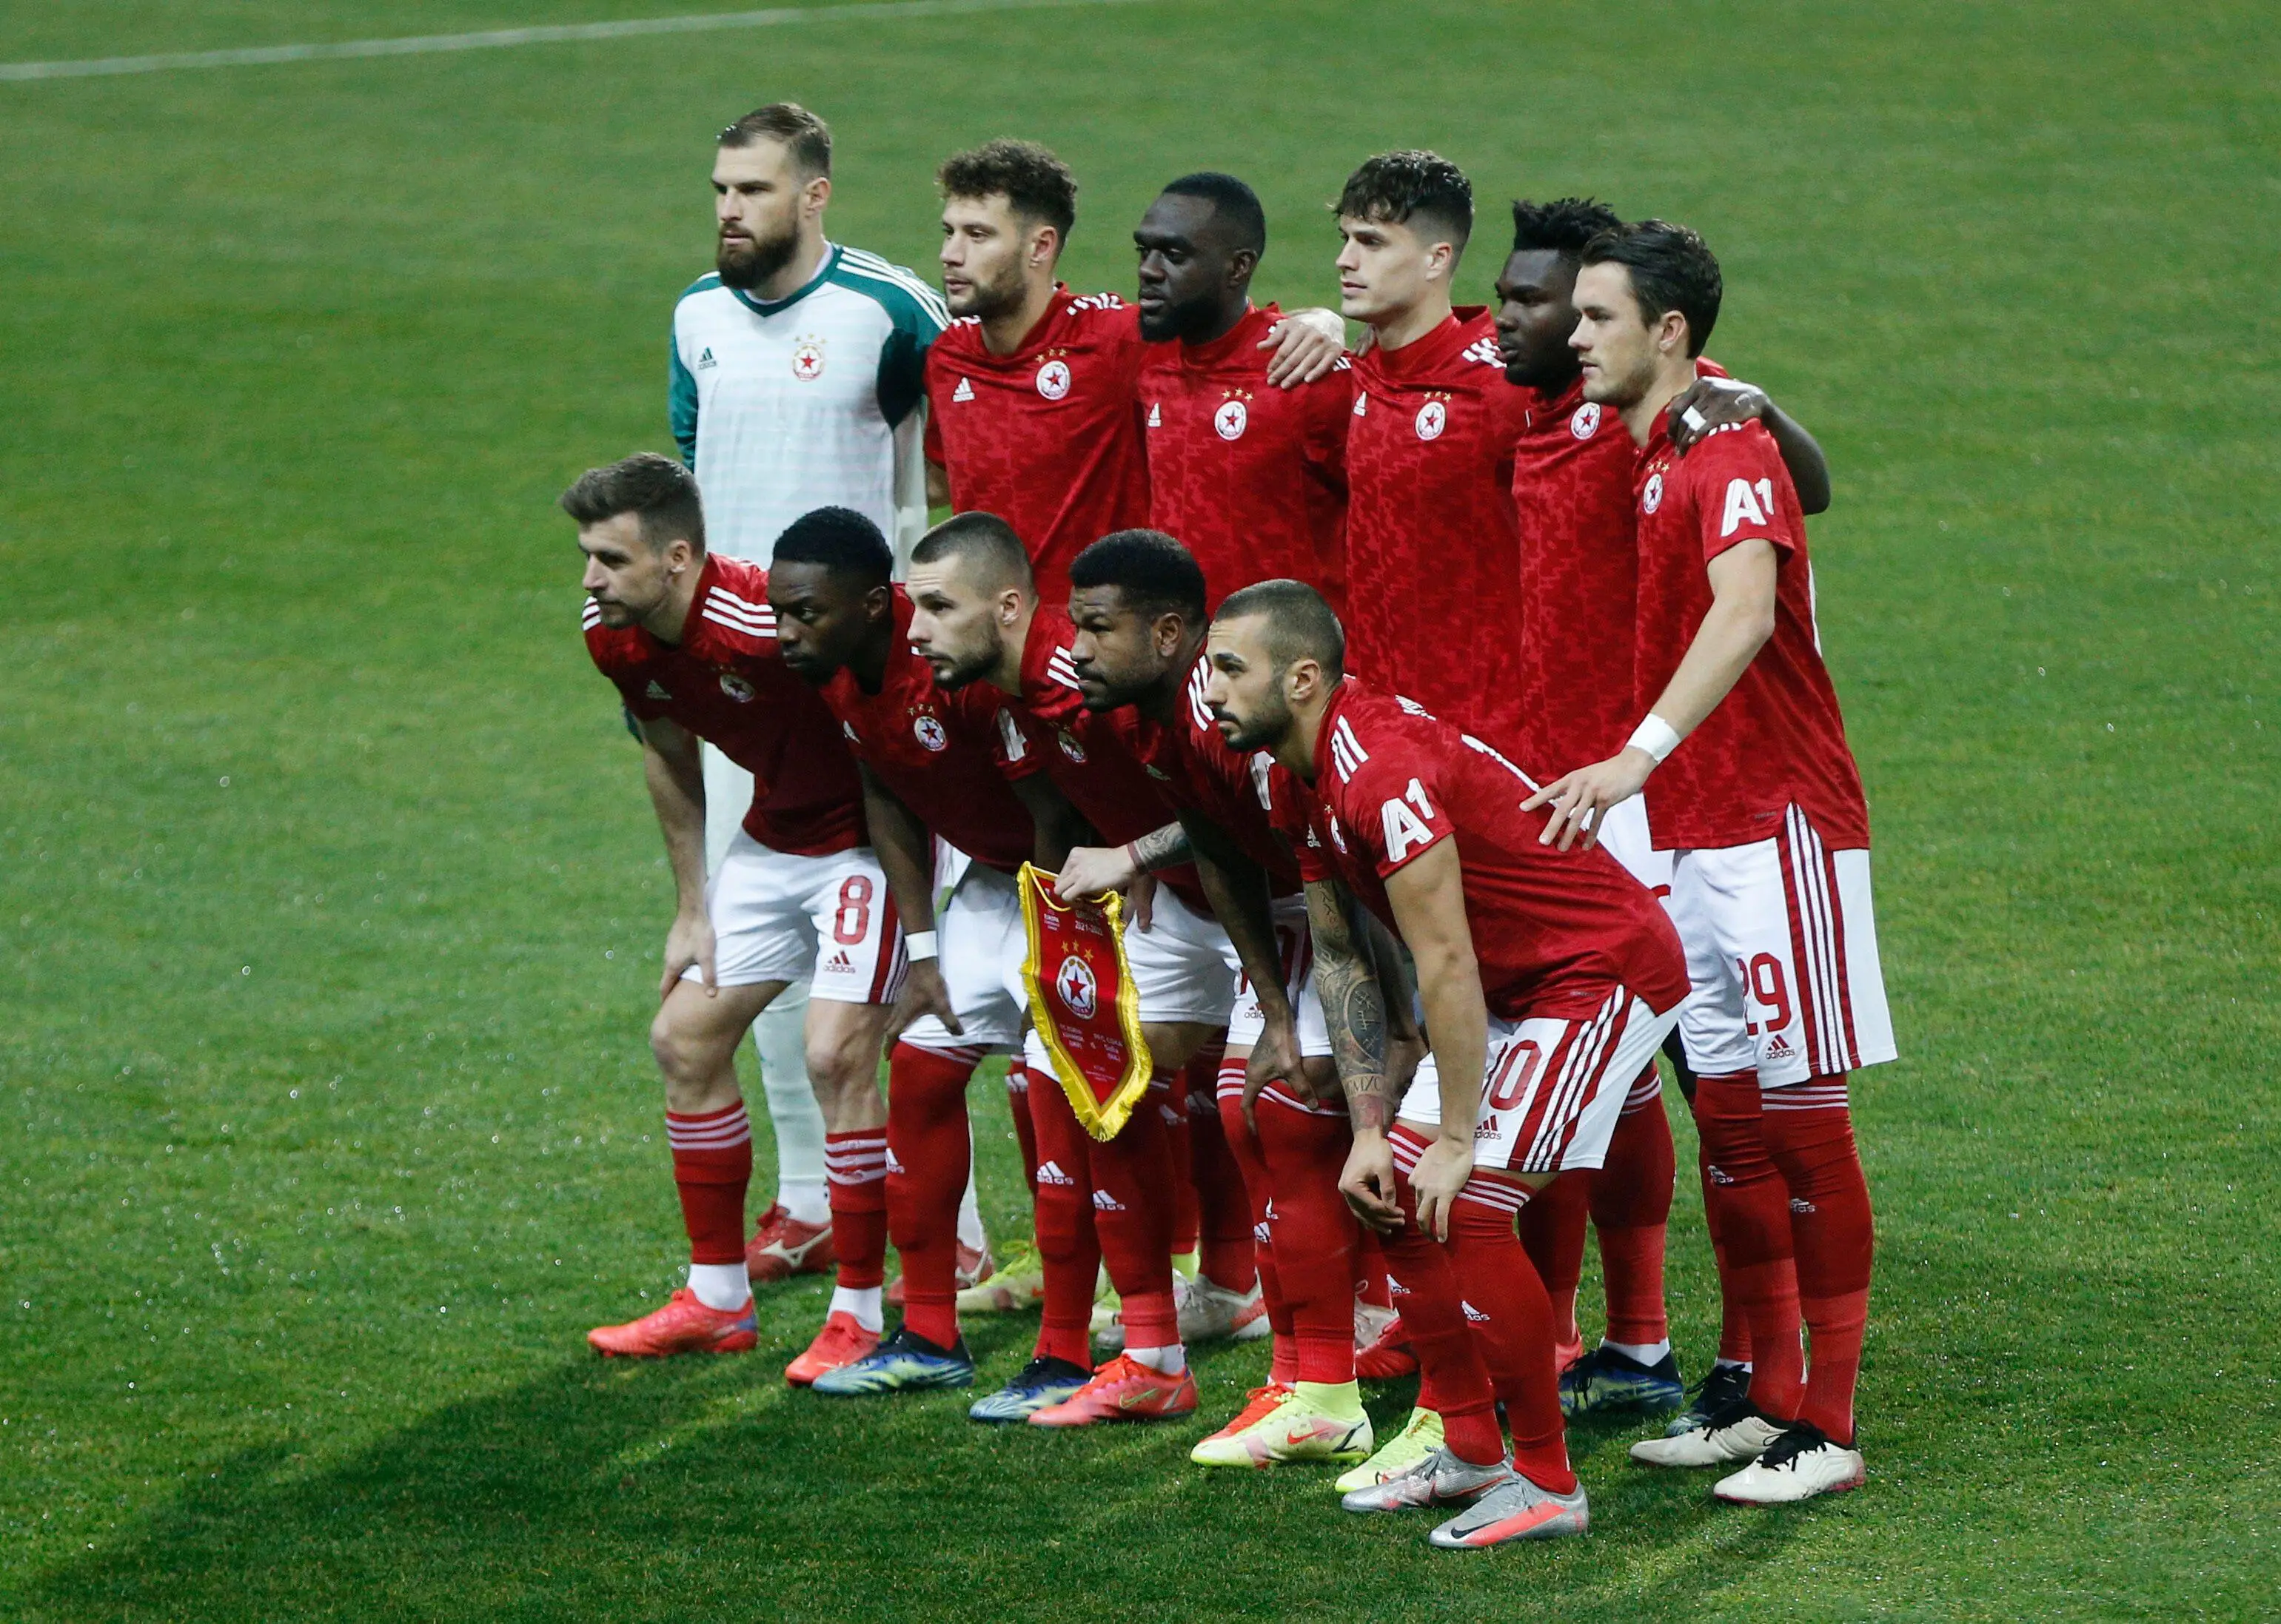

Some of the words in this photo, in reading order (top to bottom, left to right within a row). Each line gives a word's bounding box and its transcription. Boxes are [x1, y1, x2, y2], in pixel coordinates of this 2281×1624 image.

[1720, 477, 1775, 538] A1
[1381, 777, 1436, 862] A1
[834, 875, 873, 945] 8
[1481, 1039, 1542, 1110] 0
[1766, 1047, 1795, 1060] adidas
